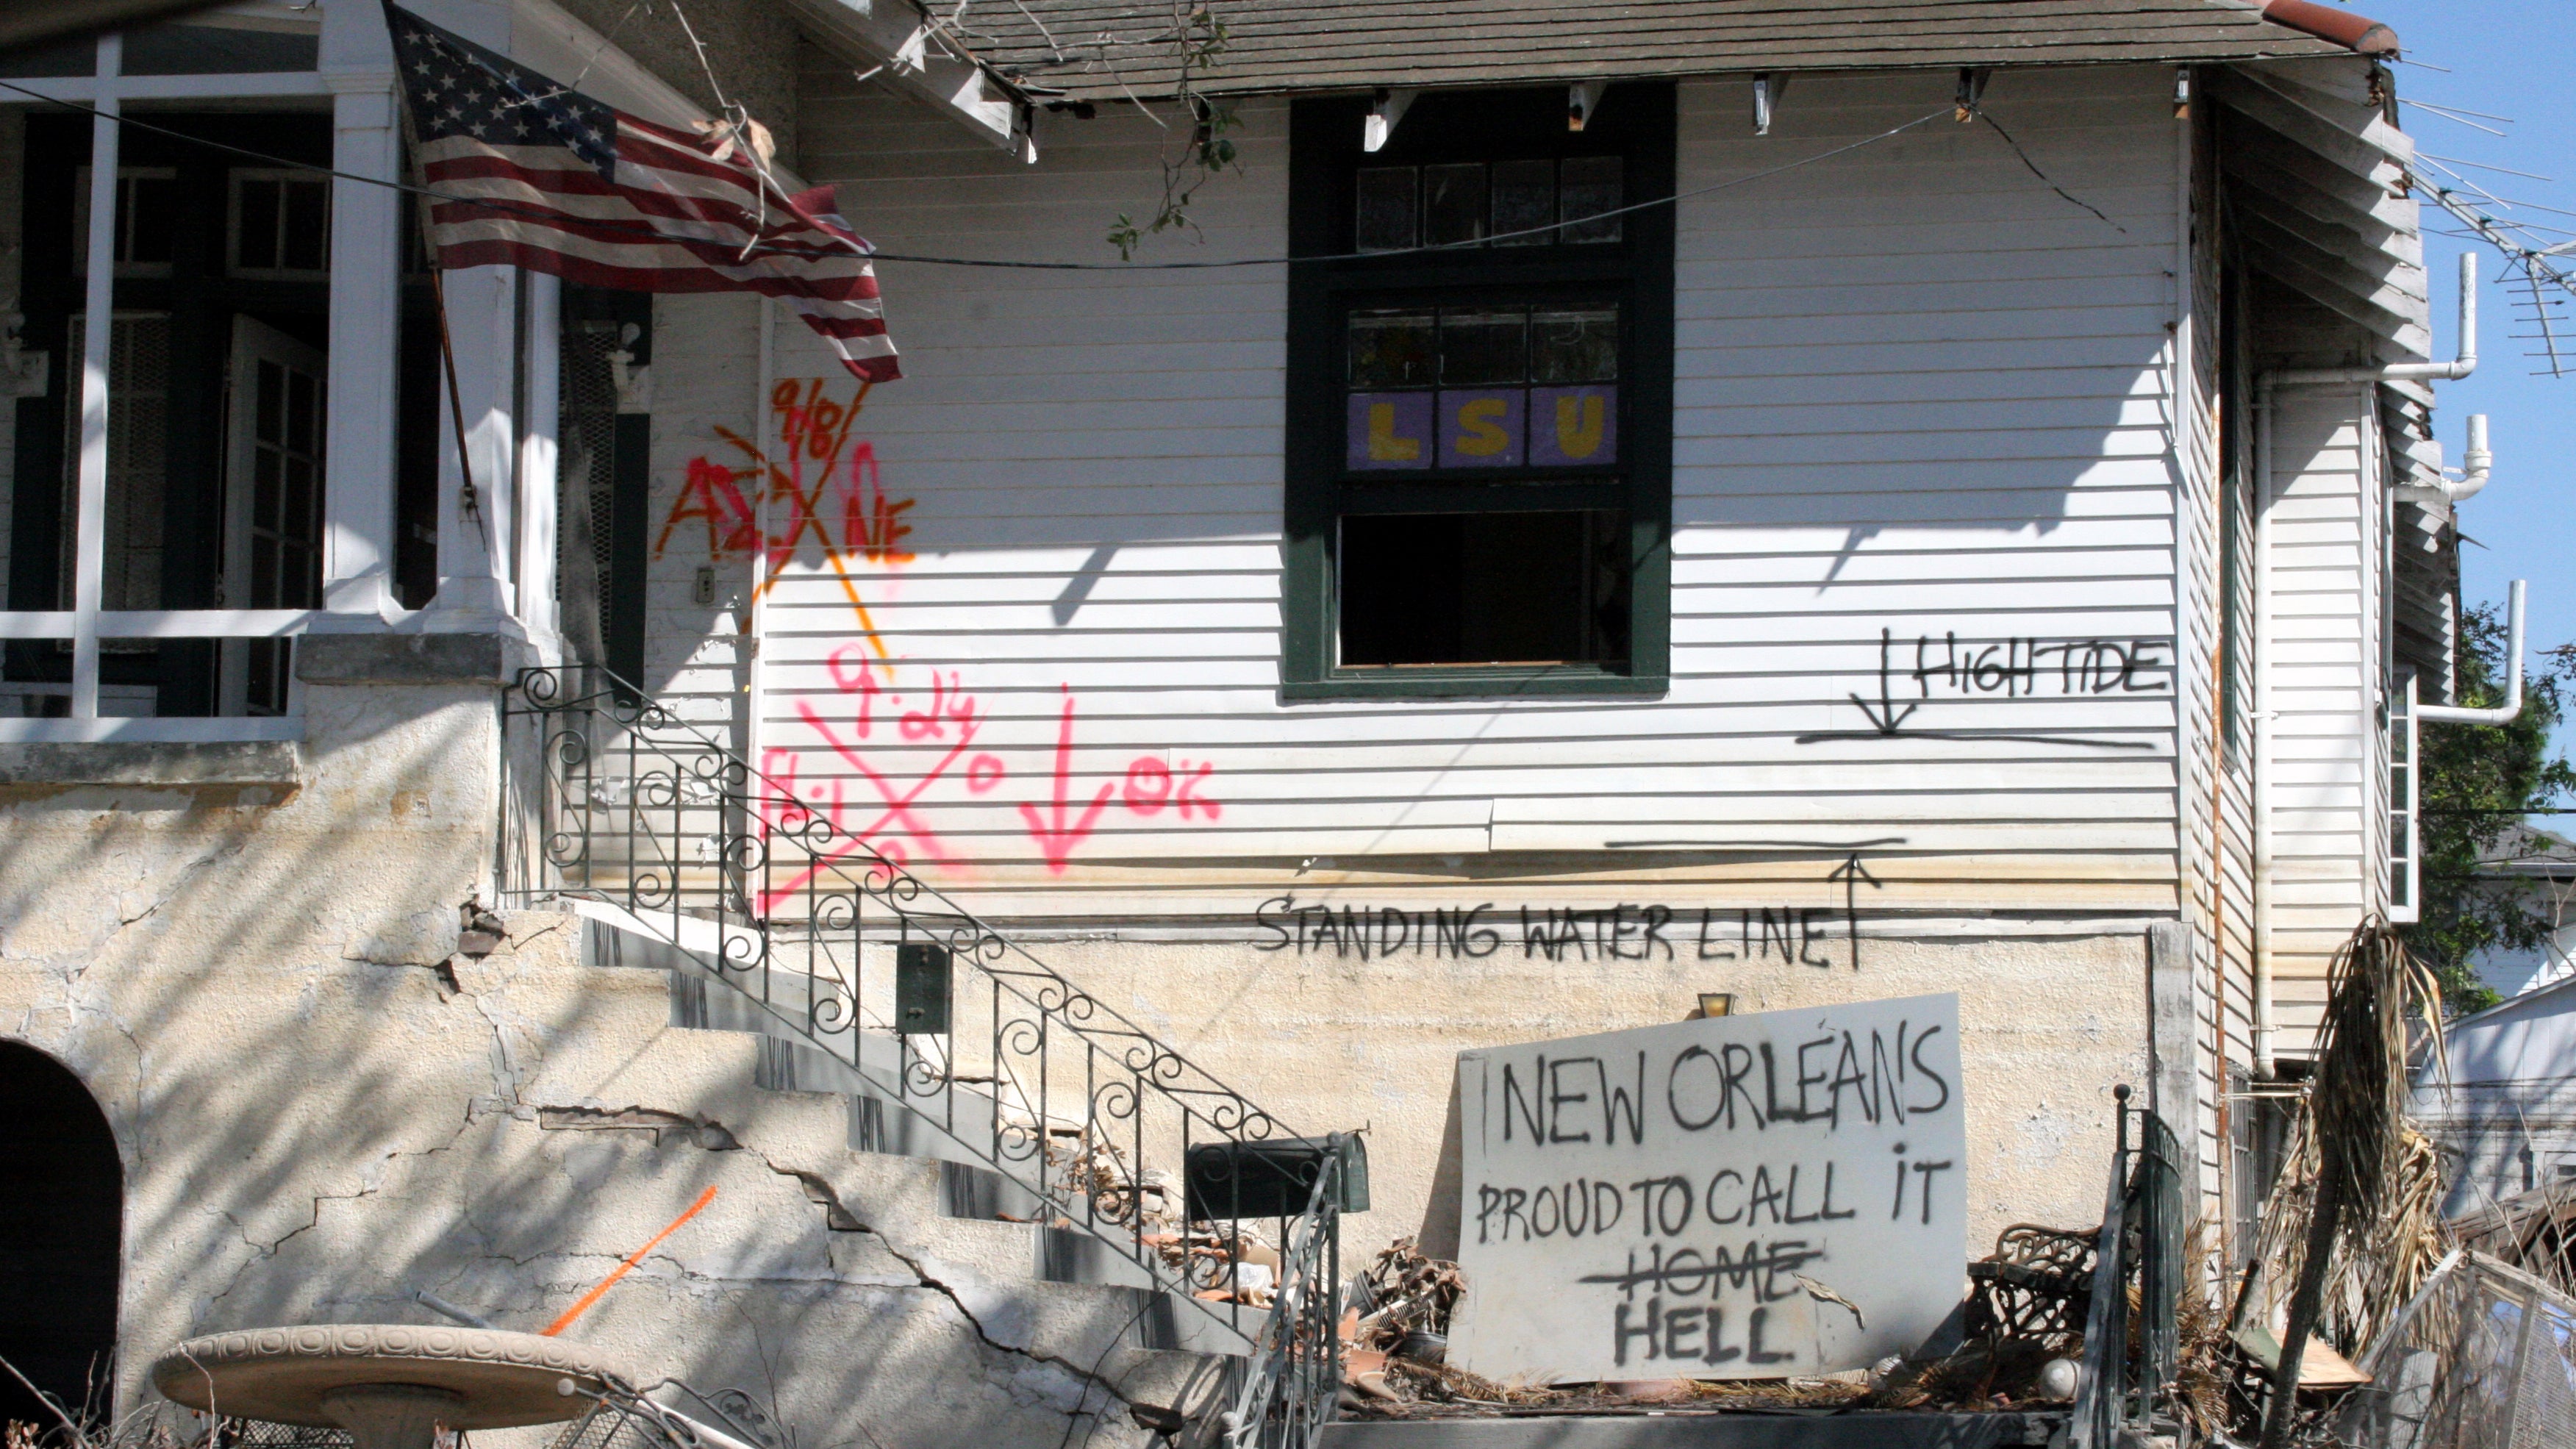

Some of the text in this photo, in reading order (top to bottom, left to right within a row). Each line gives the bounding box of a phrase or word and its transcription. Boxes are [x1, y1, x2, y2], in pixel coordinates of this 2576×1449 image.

[1368, 394, 1605, 462] LSU
[1913, 630, 2171, 698] HIGH TIDE
[1123, 756, 1222, 821] OK
[1255, 893, 1834, 969] STANDING WATER LINE
[1503, 1019, 1950, 1147] NEW ORLEANS
[1475, 1178, 1623, 1244] PROUD
[1629, 1176, 1692, 1237] TO
[1706, 1161, 1856, 1228] CALL
[1617, 1242, 1809, 1304] HOME
[1614, 1298, 1796, 1367] HELL
